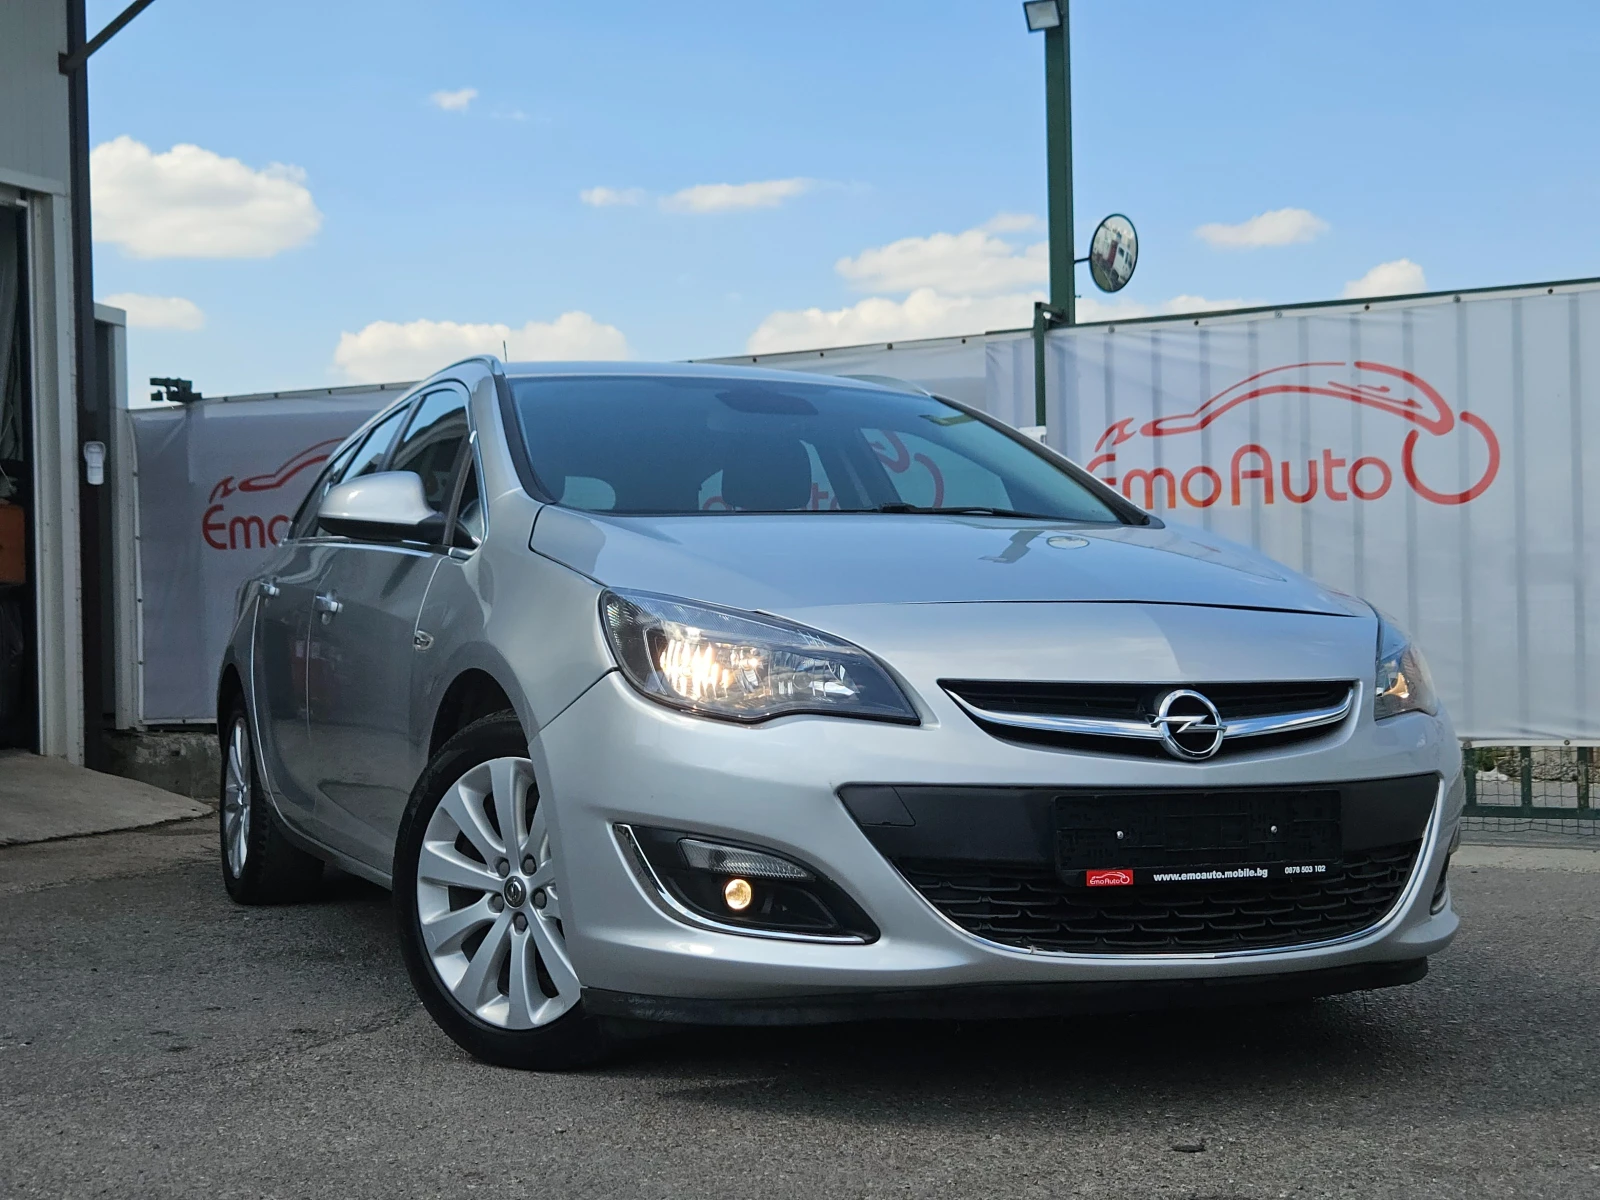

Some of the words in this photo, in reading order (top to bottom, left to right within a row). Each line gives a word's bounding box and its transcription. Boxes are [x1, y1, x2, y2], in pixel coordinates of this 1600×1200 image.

[1153, 868, 1268, 881] www.emoauto.mobile.bg
[1301, 865, 1313, 873] 503
[1314, 864, 1326, 872] 102
